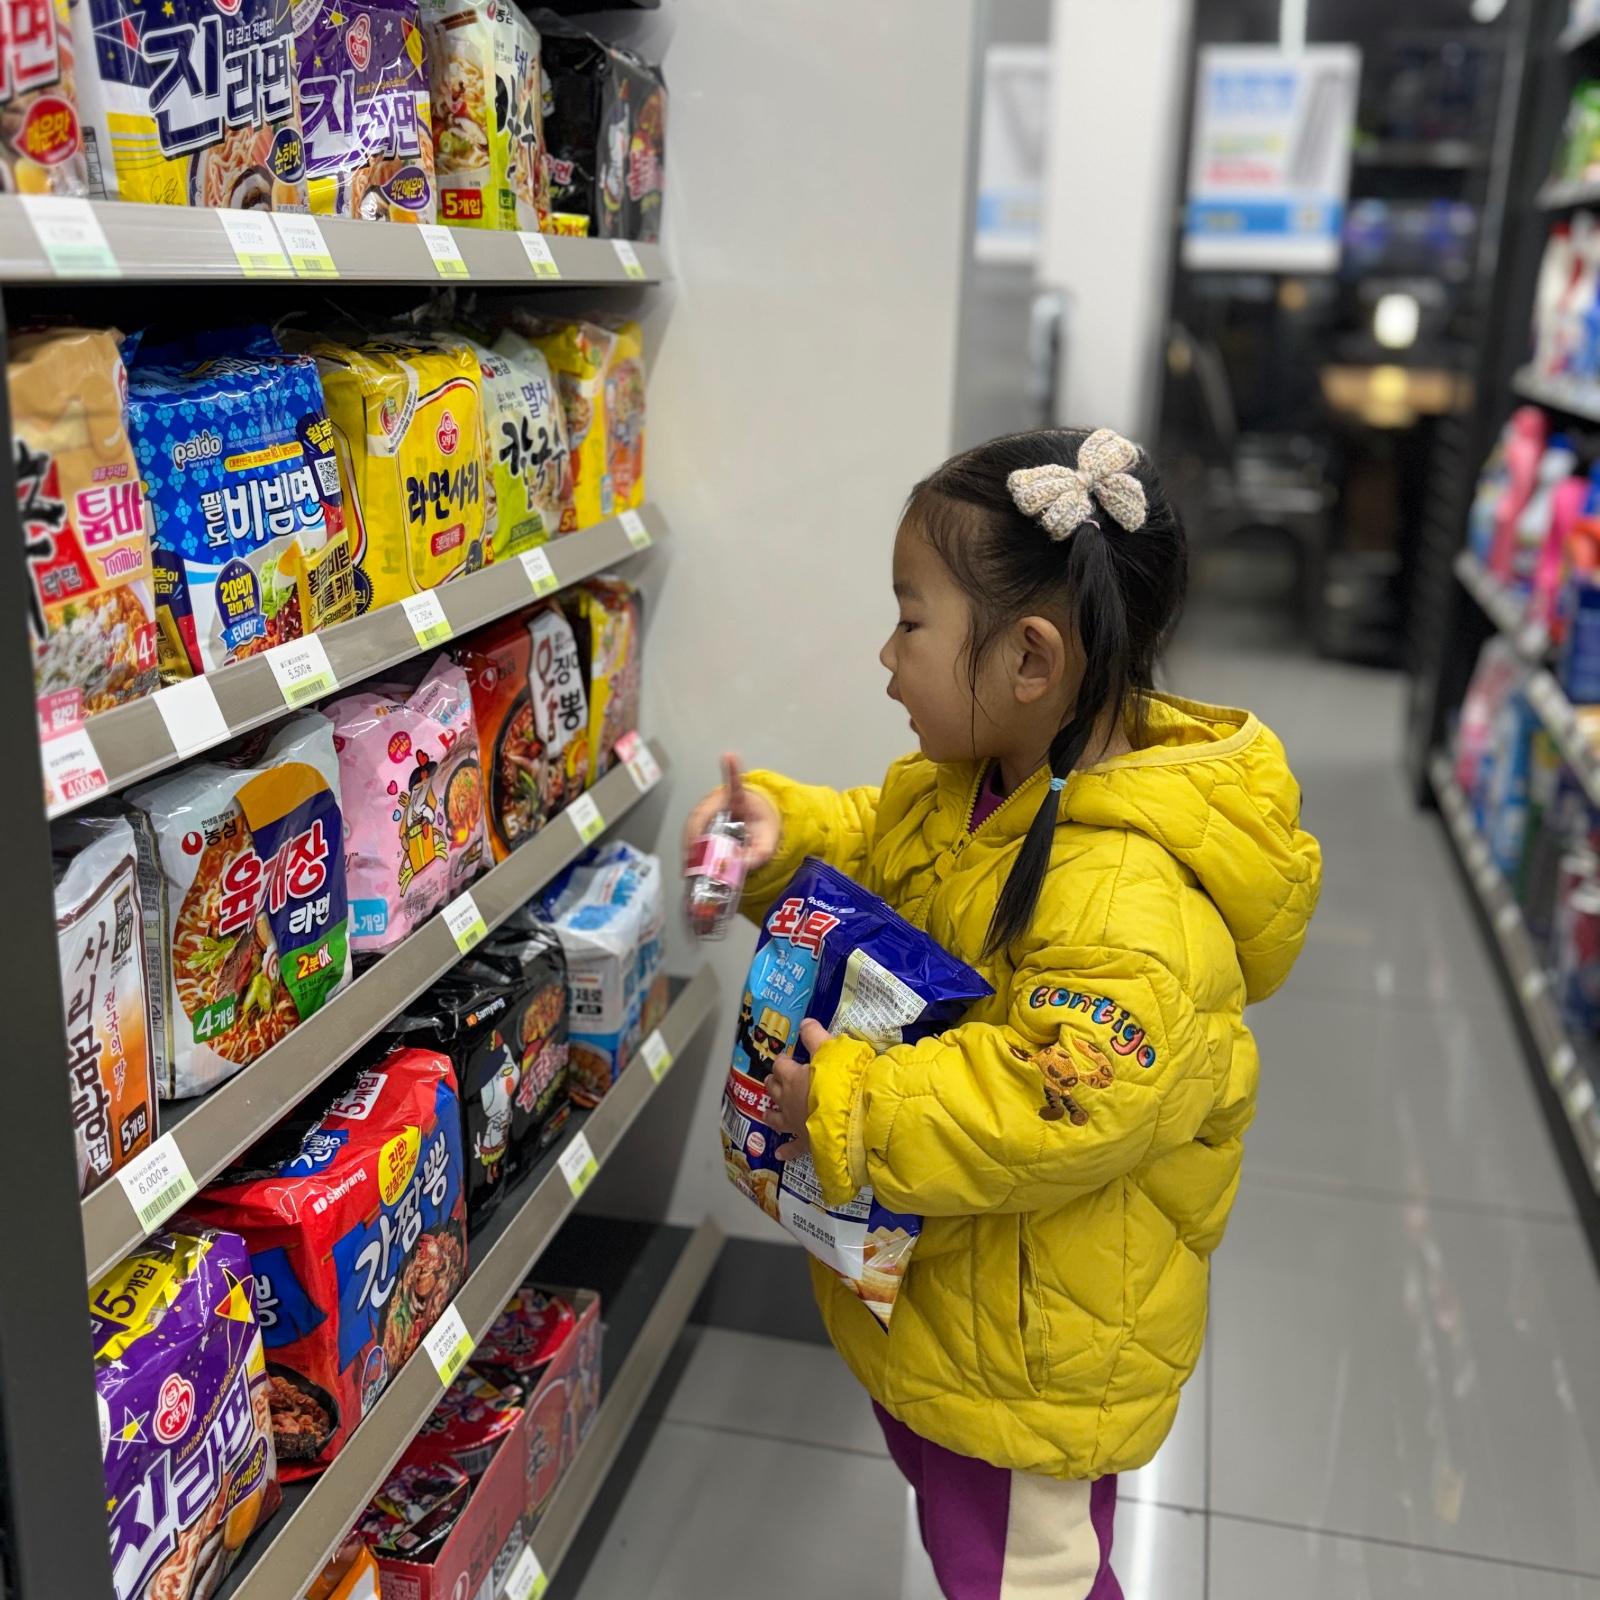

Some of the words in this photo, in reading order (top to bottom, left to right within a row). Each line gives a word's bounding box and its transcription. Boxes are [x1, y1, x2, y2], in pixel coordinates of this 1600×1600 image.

[0, 0, 59, 95] 면
[140, 14, 297, 160] 진라면
[27, 112, 71, 153] 매운맛
[274, 137, 302, 175] 순한맛
[445, 191, 482, 216] 5개입
[173, 430, 222, 470] paldo
[222, 466, 325, 541] 비빔면
[406, 460, 479, 526] 라면사리
[76, 480, 144, 547] 툼바
[201, 489, 230, 548] 팔도
[98, 547, 143, 578] Toomba
[220, 572, 254, 604] 20억개
[227, 598, 244, 618] 판매
[231, 617, 258, 643] EVENT
[204, 819, 238, 848] 농심
[219, 819, 329, 936] 육개장
[288, 892, 331, 934] 라면
[196, 1003, 235, 1038] 4개입
[475, 998, 507, 1021] Samyang
[1030, 986, 1156, 1068] contigo
[121, 1112, 147, 1152] 5개입
[325, 1168, 368, 1206] Samyang
[354, 1131, 449, 1312] 간짬뽕
[95, 1263, 158, 1319] 5개입
[164, 1401, 189, 1433] 오뚜기
[175, 1427, 205, 1465] Limited
